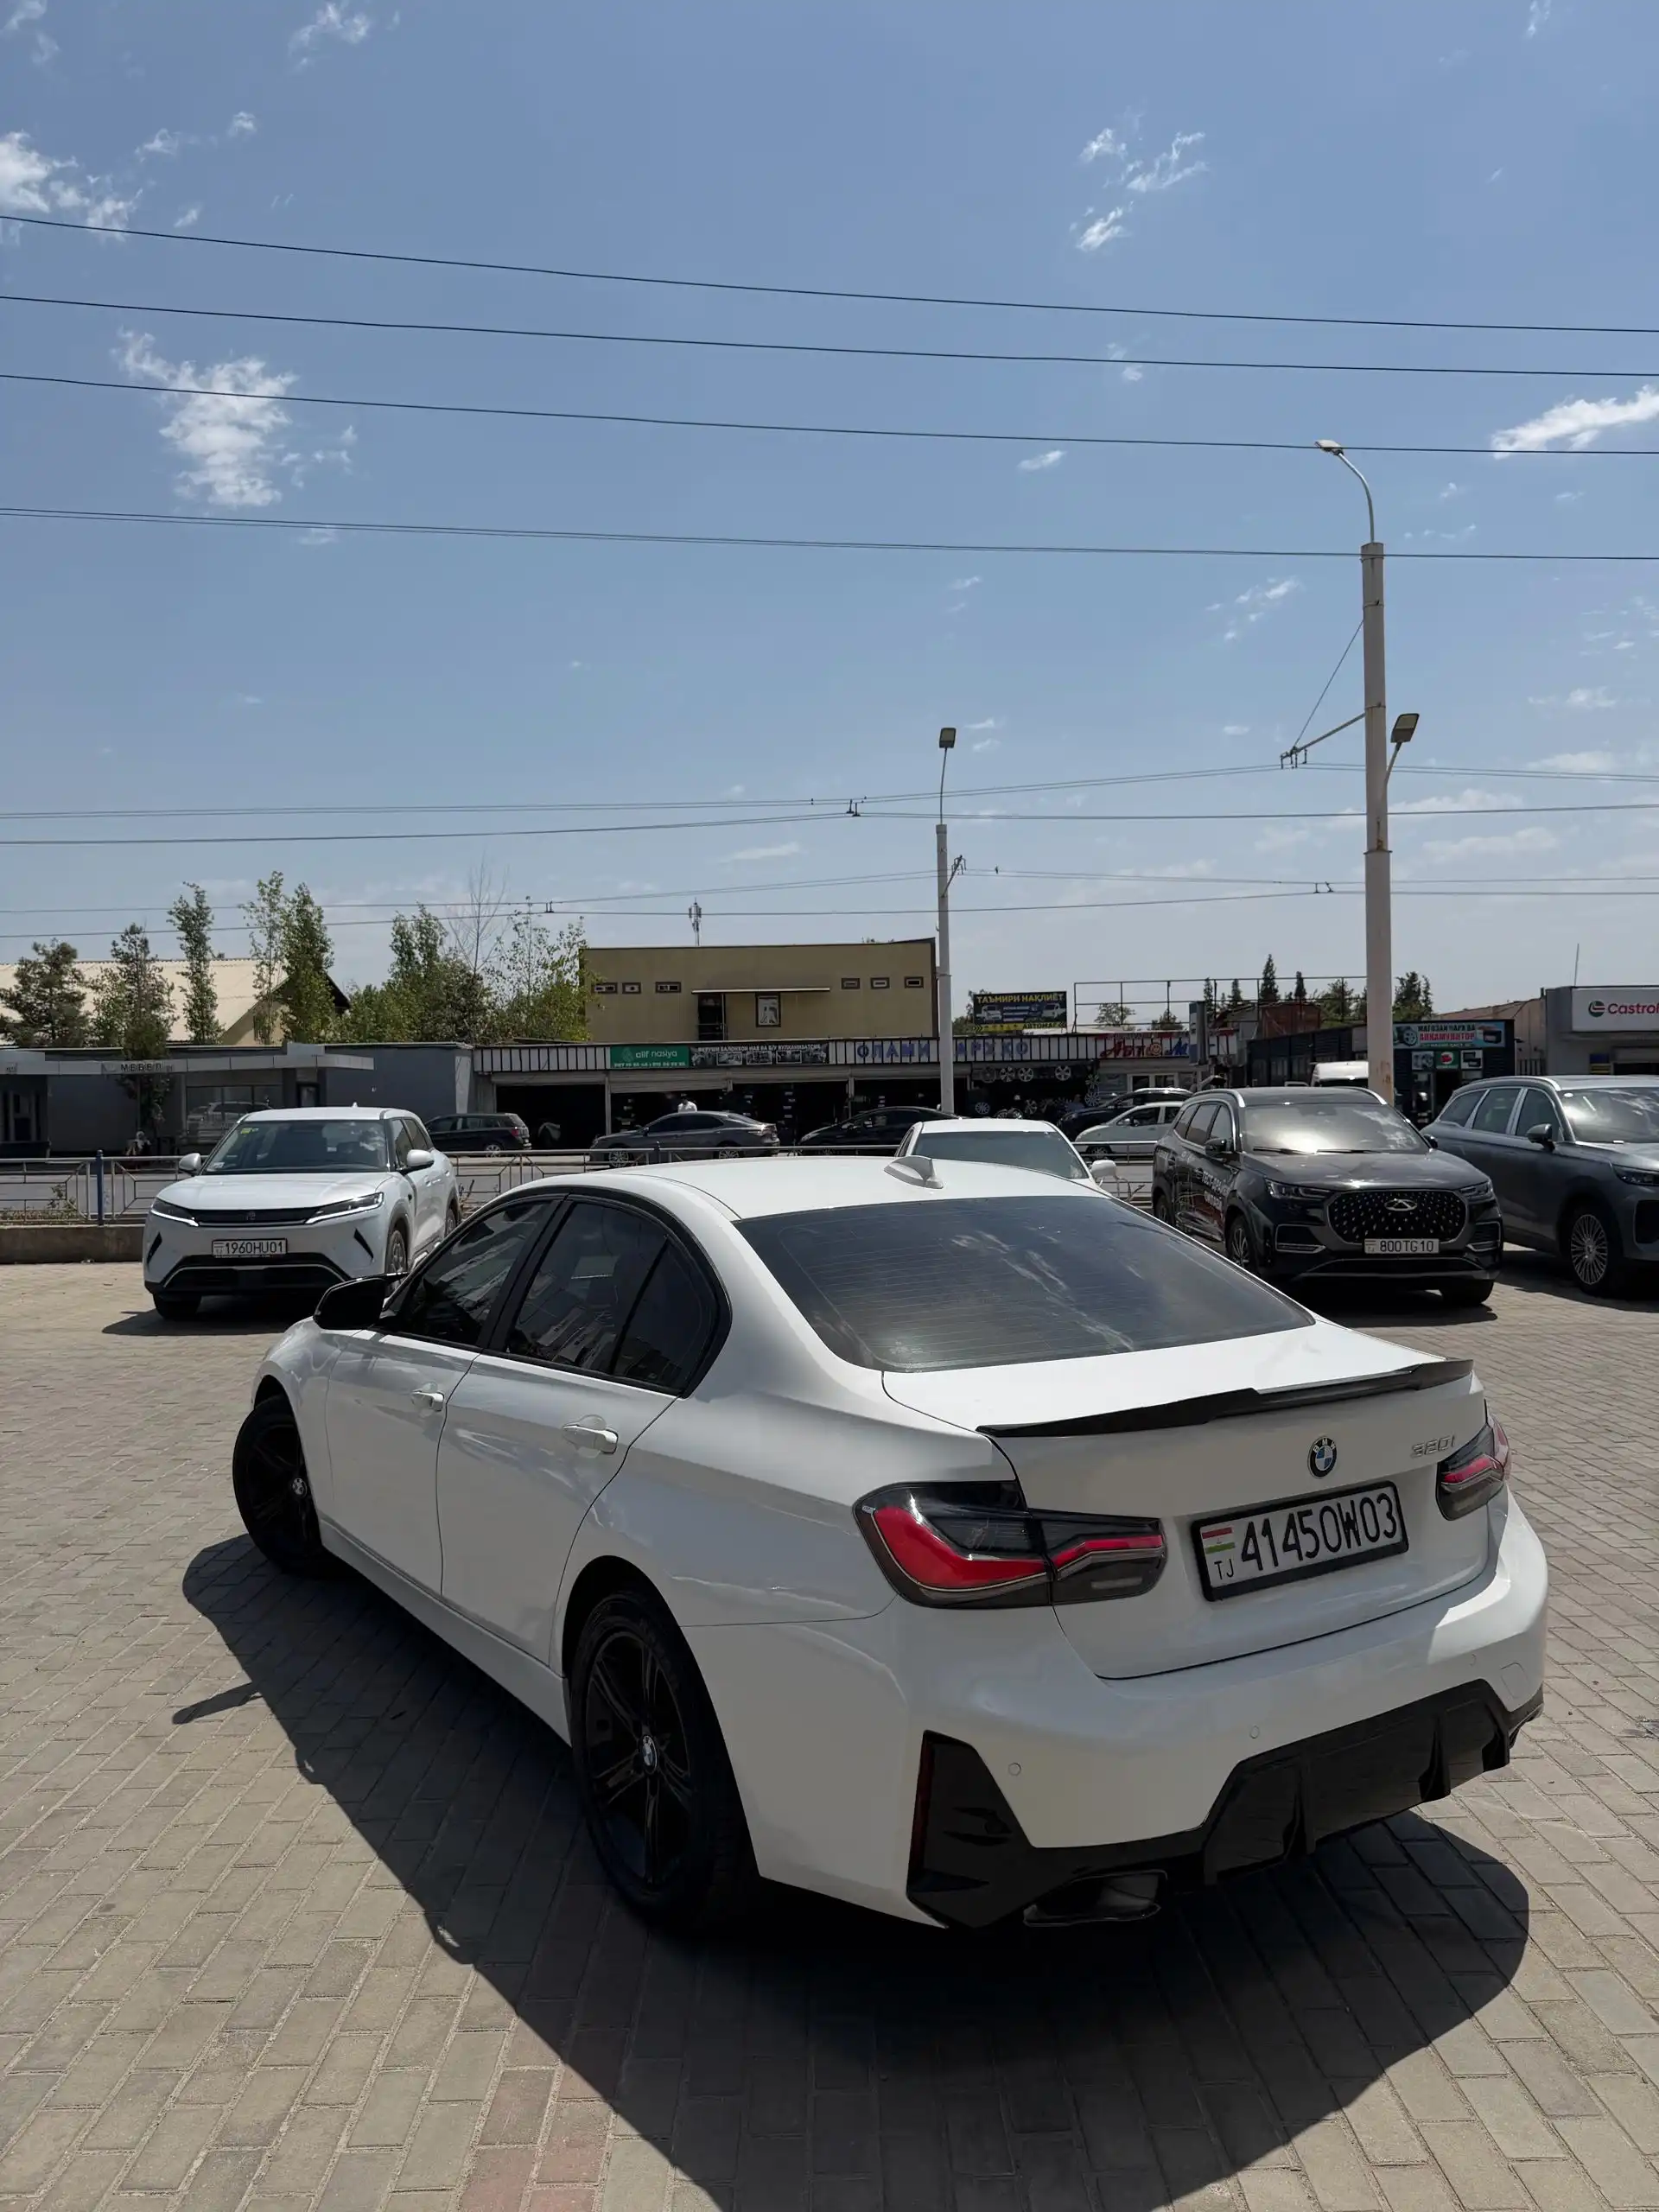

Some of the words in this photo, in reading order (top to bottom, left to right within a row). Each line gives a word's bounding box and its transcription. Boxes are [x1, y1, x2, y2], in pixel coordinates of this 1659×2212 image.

[1608, 1002, 1659, 1014] Castrol
[651, 1049, 677, 1059] nasiya
[226, 1241, 283, 1254] 1960HU01
[1214, 1558, 1234, 1580] TJ
